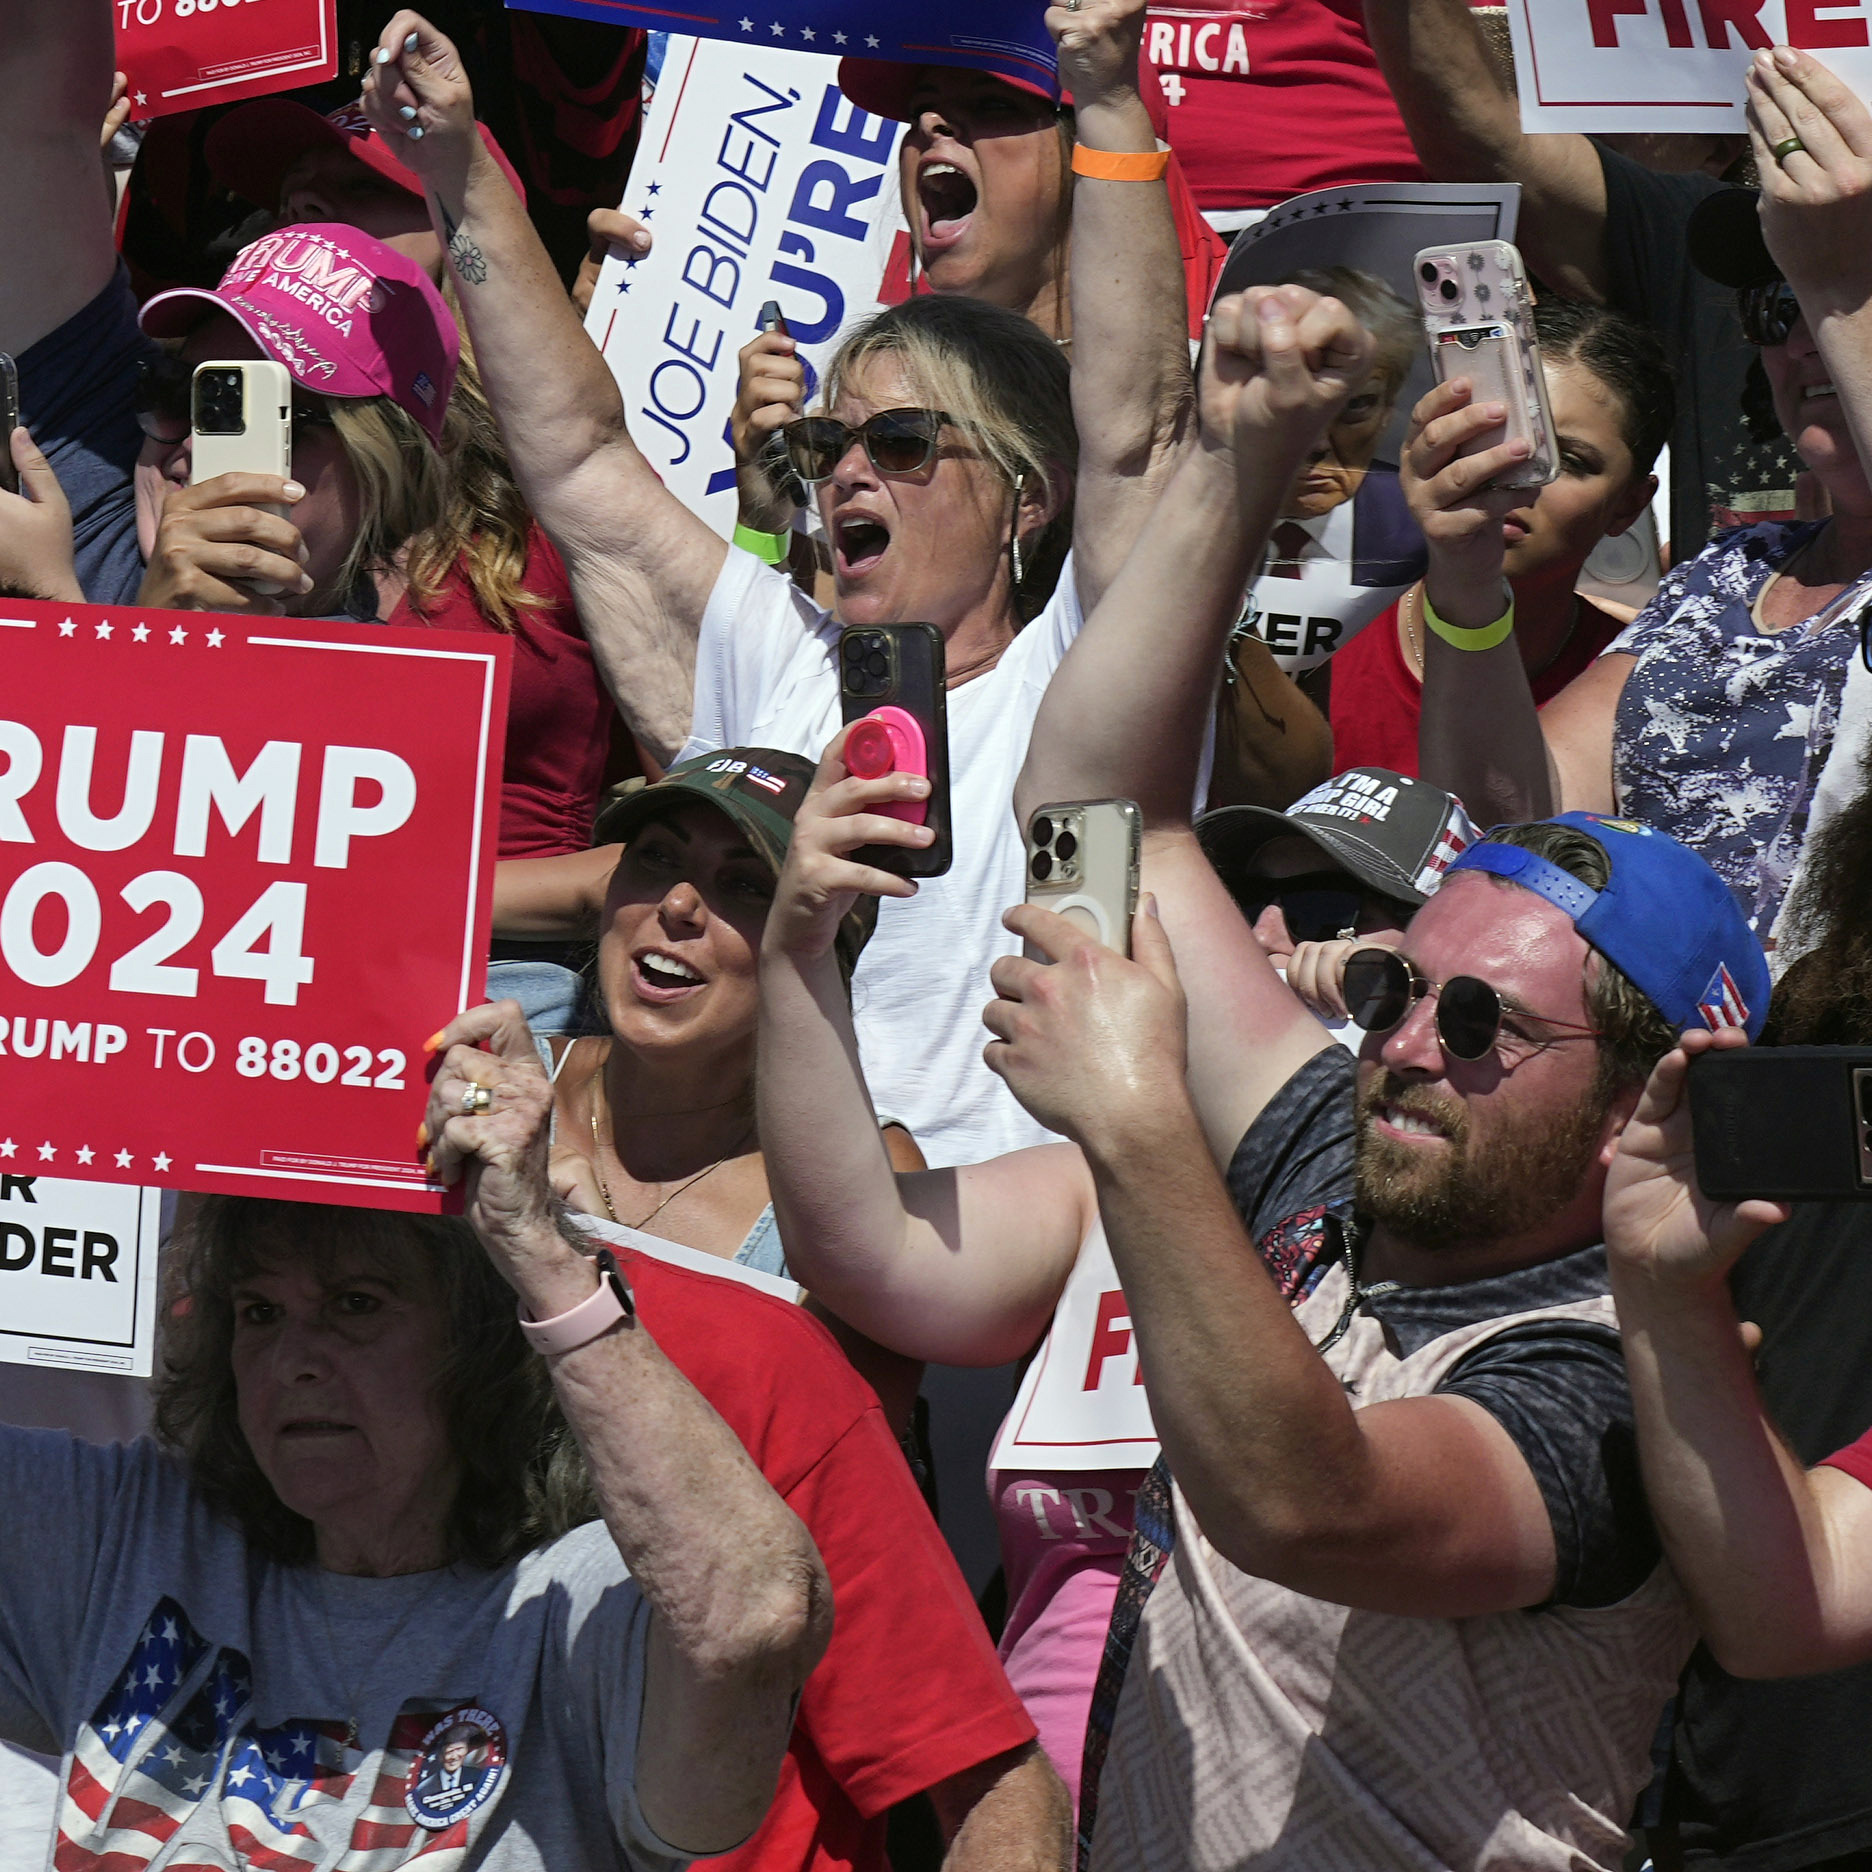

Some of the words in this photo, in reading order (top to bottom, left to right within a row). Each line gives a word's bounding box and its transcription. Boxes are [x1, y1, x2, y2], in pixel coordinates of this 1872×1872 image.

[681, 73, 802, 310] BIDEN,
[232, 235, 387, 314] TRUMP
[261, 272, 353, 338] AMERICA
[642, 301, 725, 465] JOE
[1336, 772, 1382, 797] I'M
[1373, 786, 1400, 807] A
[1338, 790, 1392, 822] GIRL
[146, 1026, 216, 1075] TO
[233, 1035, 407, 1092] 88022
